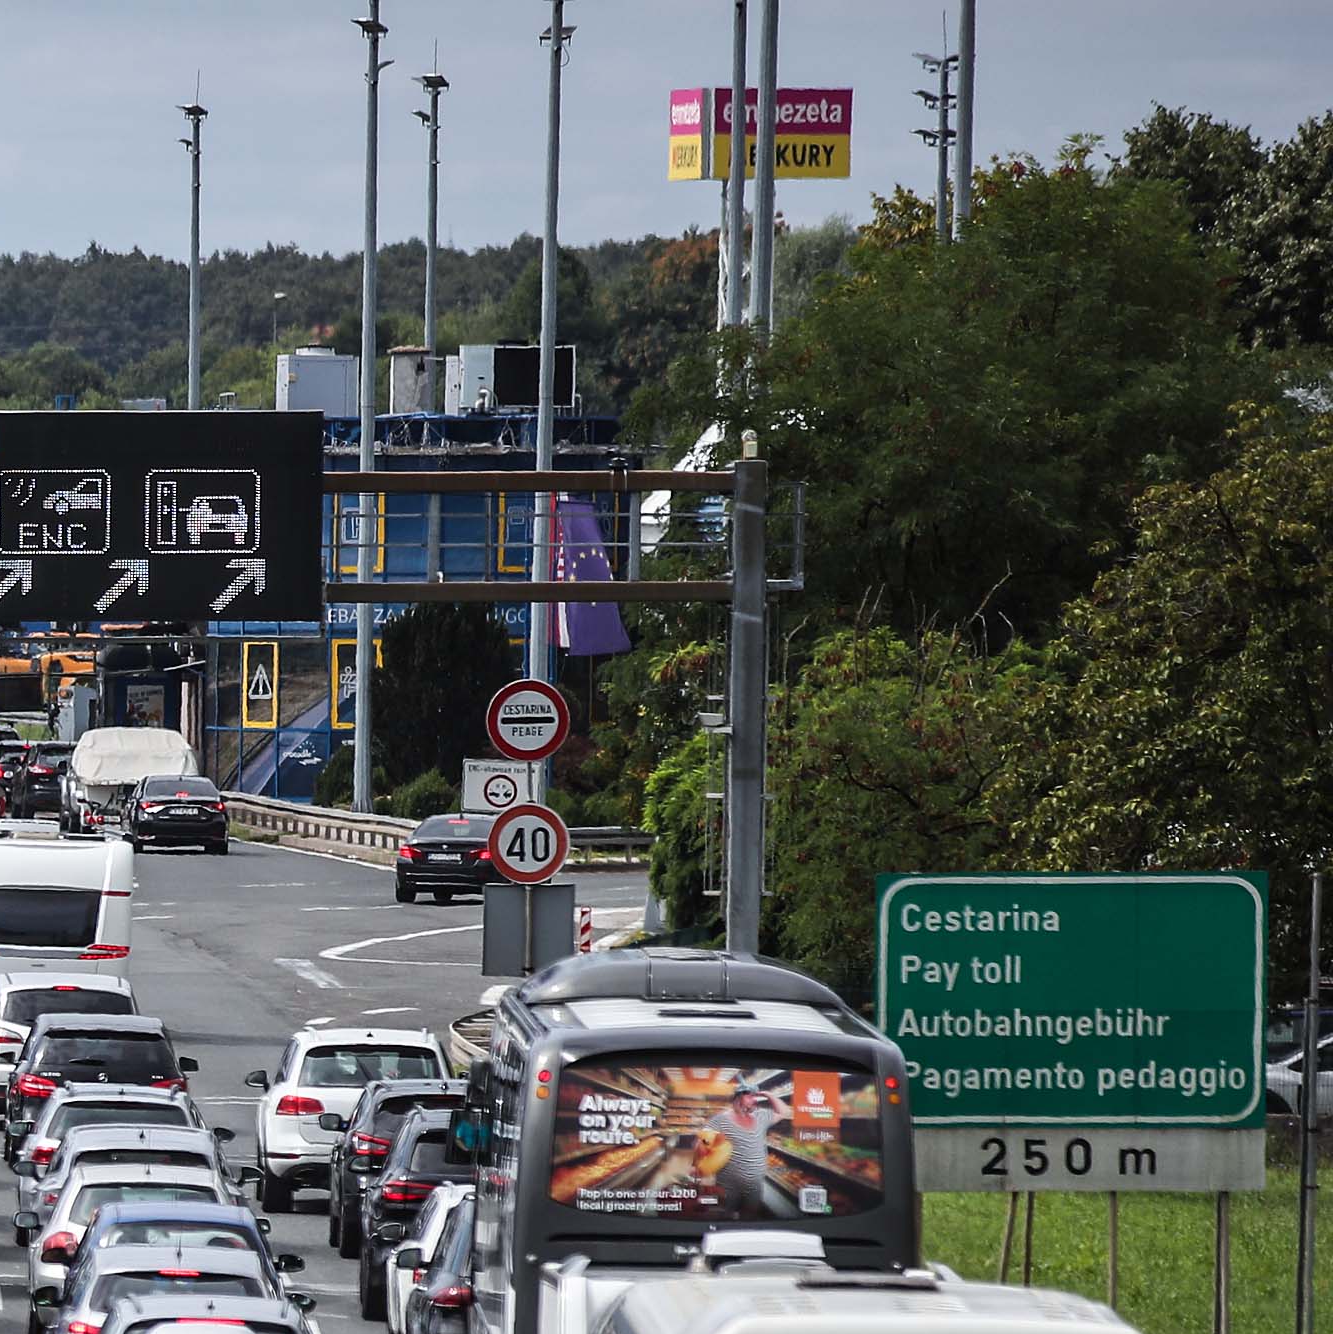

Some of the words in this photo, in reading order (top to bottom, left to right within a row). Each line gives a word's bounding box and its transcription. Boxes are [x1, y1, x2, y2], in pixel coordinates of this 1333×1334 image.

[723, 99, 842, 123] emezeta
[728, 144, 834, 168] EKURY
[18, 523, 87, 549] ENC
[503, 704, 552, 716] CESTARINA
[512, 726, 544, 736] PEAGE
[506, 827, 550, 862] 40
[900, 904, 1061, 932] Cestarina
[900, 955, 960, 991] Pay
[970, 955, 1022, 984] toll
[897, 1008, 1170, 1044] Autobahngebühr
[905, 1061, 1085, 1098] Pagamento
[1097, 1060, 1247, 1097] pedaggio
[580, 1094, 652, 1115] Always
[580, 1114, 606, 1129] on
[609, 1114, 656, 1133] your
[580, 1131, 640, 1145] route.
[980, 1137, 1092, 1176] 250
[1118, 1147, 1157, 1175] m
[606, 1201, 646, 1213] grocery
